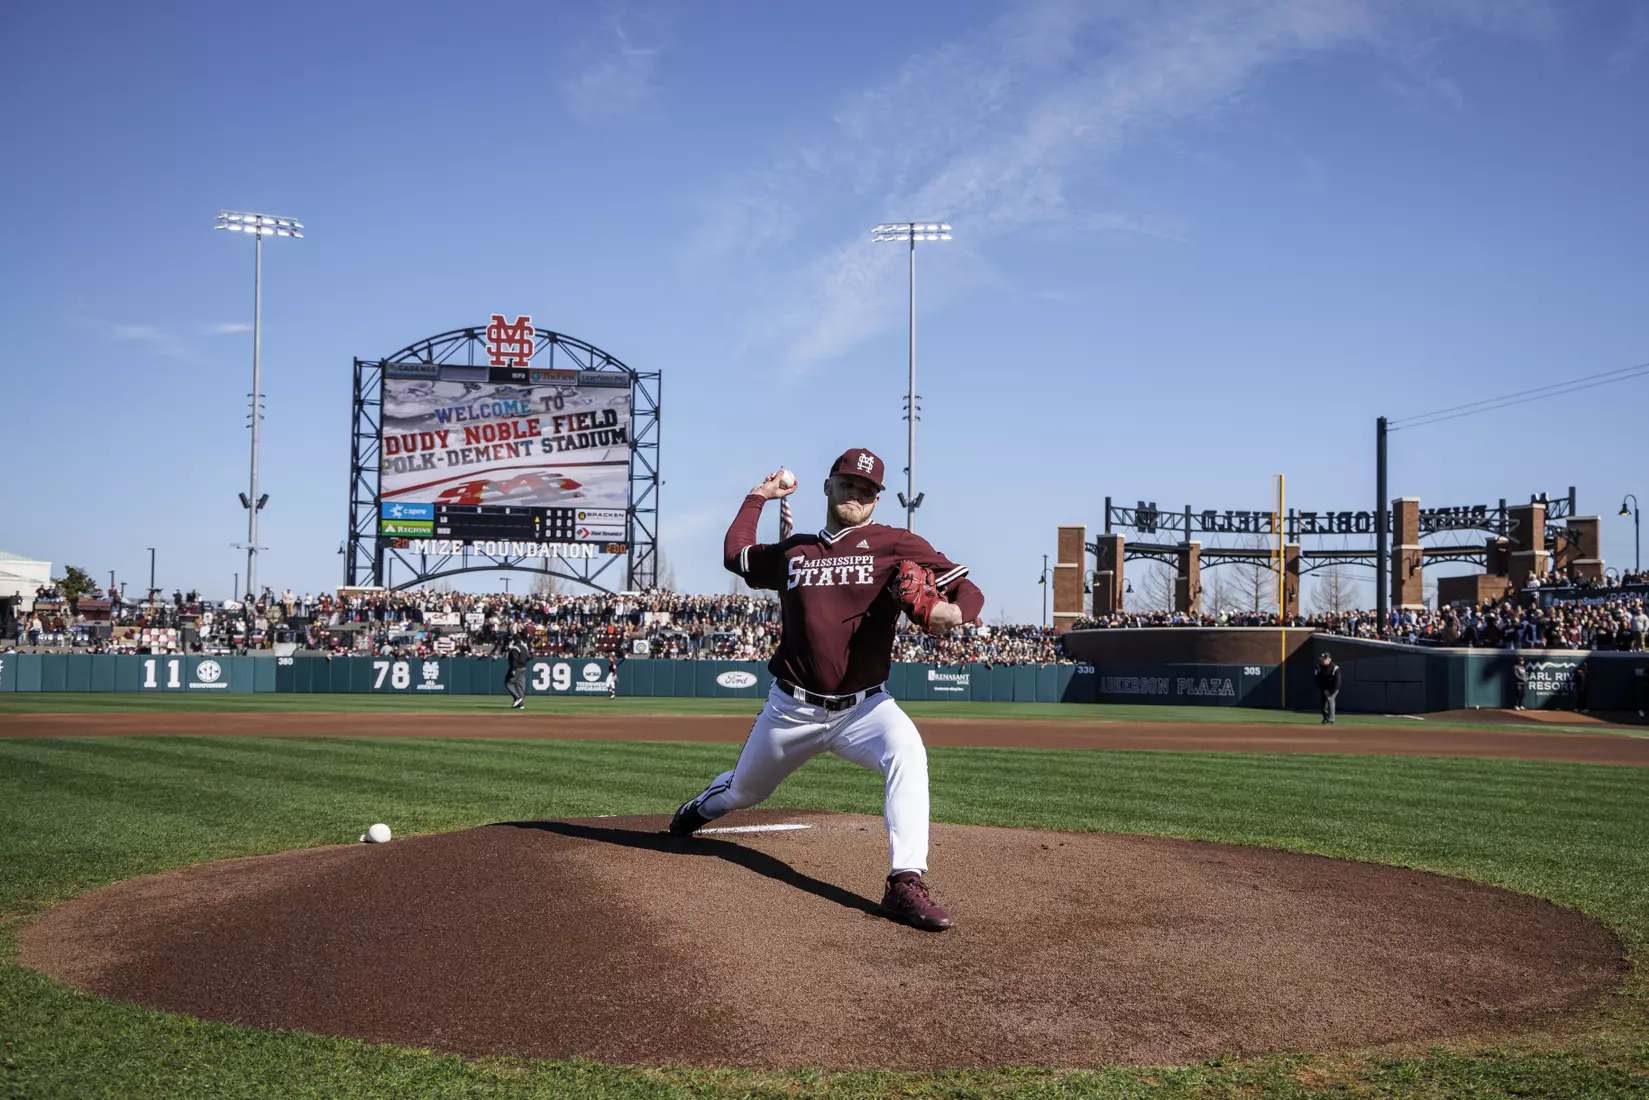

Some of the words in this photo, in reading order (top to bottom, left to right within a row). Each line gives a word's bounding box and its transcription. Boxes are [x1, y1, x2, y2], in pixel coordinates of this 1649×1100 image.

[434, 399, 532, 424] WELCOME
[539, 395, 564, 412] TO
[383, 429, 450, 456] DUDY
[464, 418, 542, 446] NOBLE
[552, 408, 618, 434] FIELD
[382, 440, 534, 476] POLK-DEMENT
[542, 427, 628, 454] STADIUM
[414, 539, 464, 556] MIZE
[472, 540, 595, 558] FOUNDATION
[803, 556, 875, 568] MISSISSIPPI
[786, 554, 875, 590] STATE
[373, 661, 410, 690] 78
[532, 662, 572, 690] 39
[724, 673, 748, 684] Ford
[1078, 666, 1095, 674] 330
[1244, 666, 1262, 676] 305
[1176, 678, 1236, 696] PLAZA
[1528, 682, 1576, 691] RESORT
